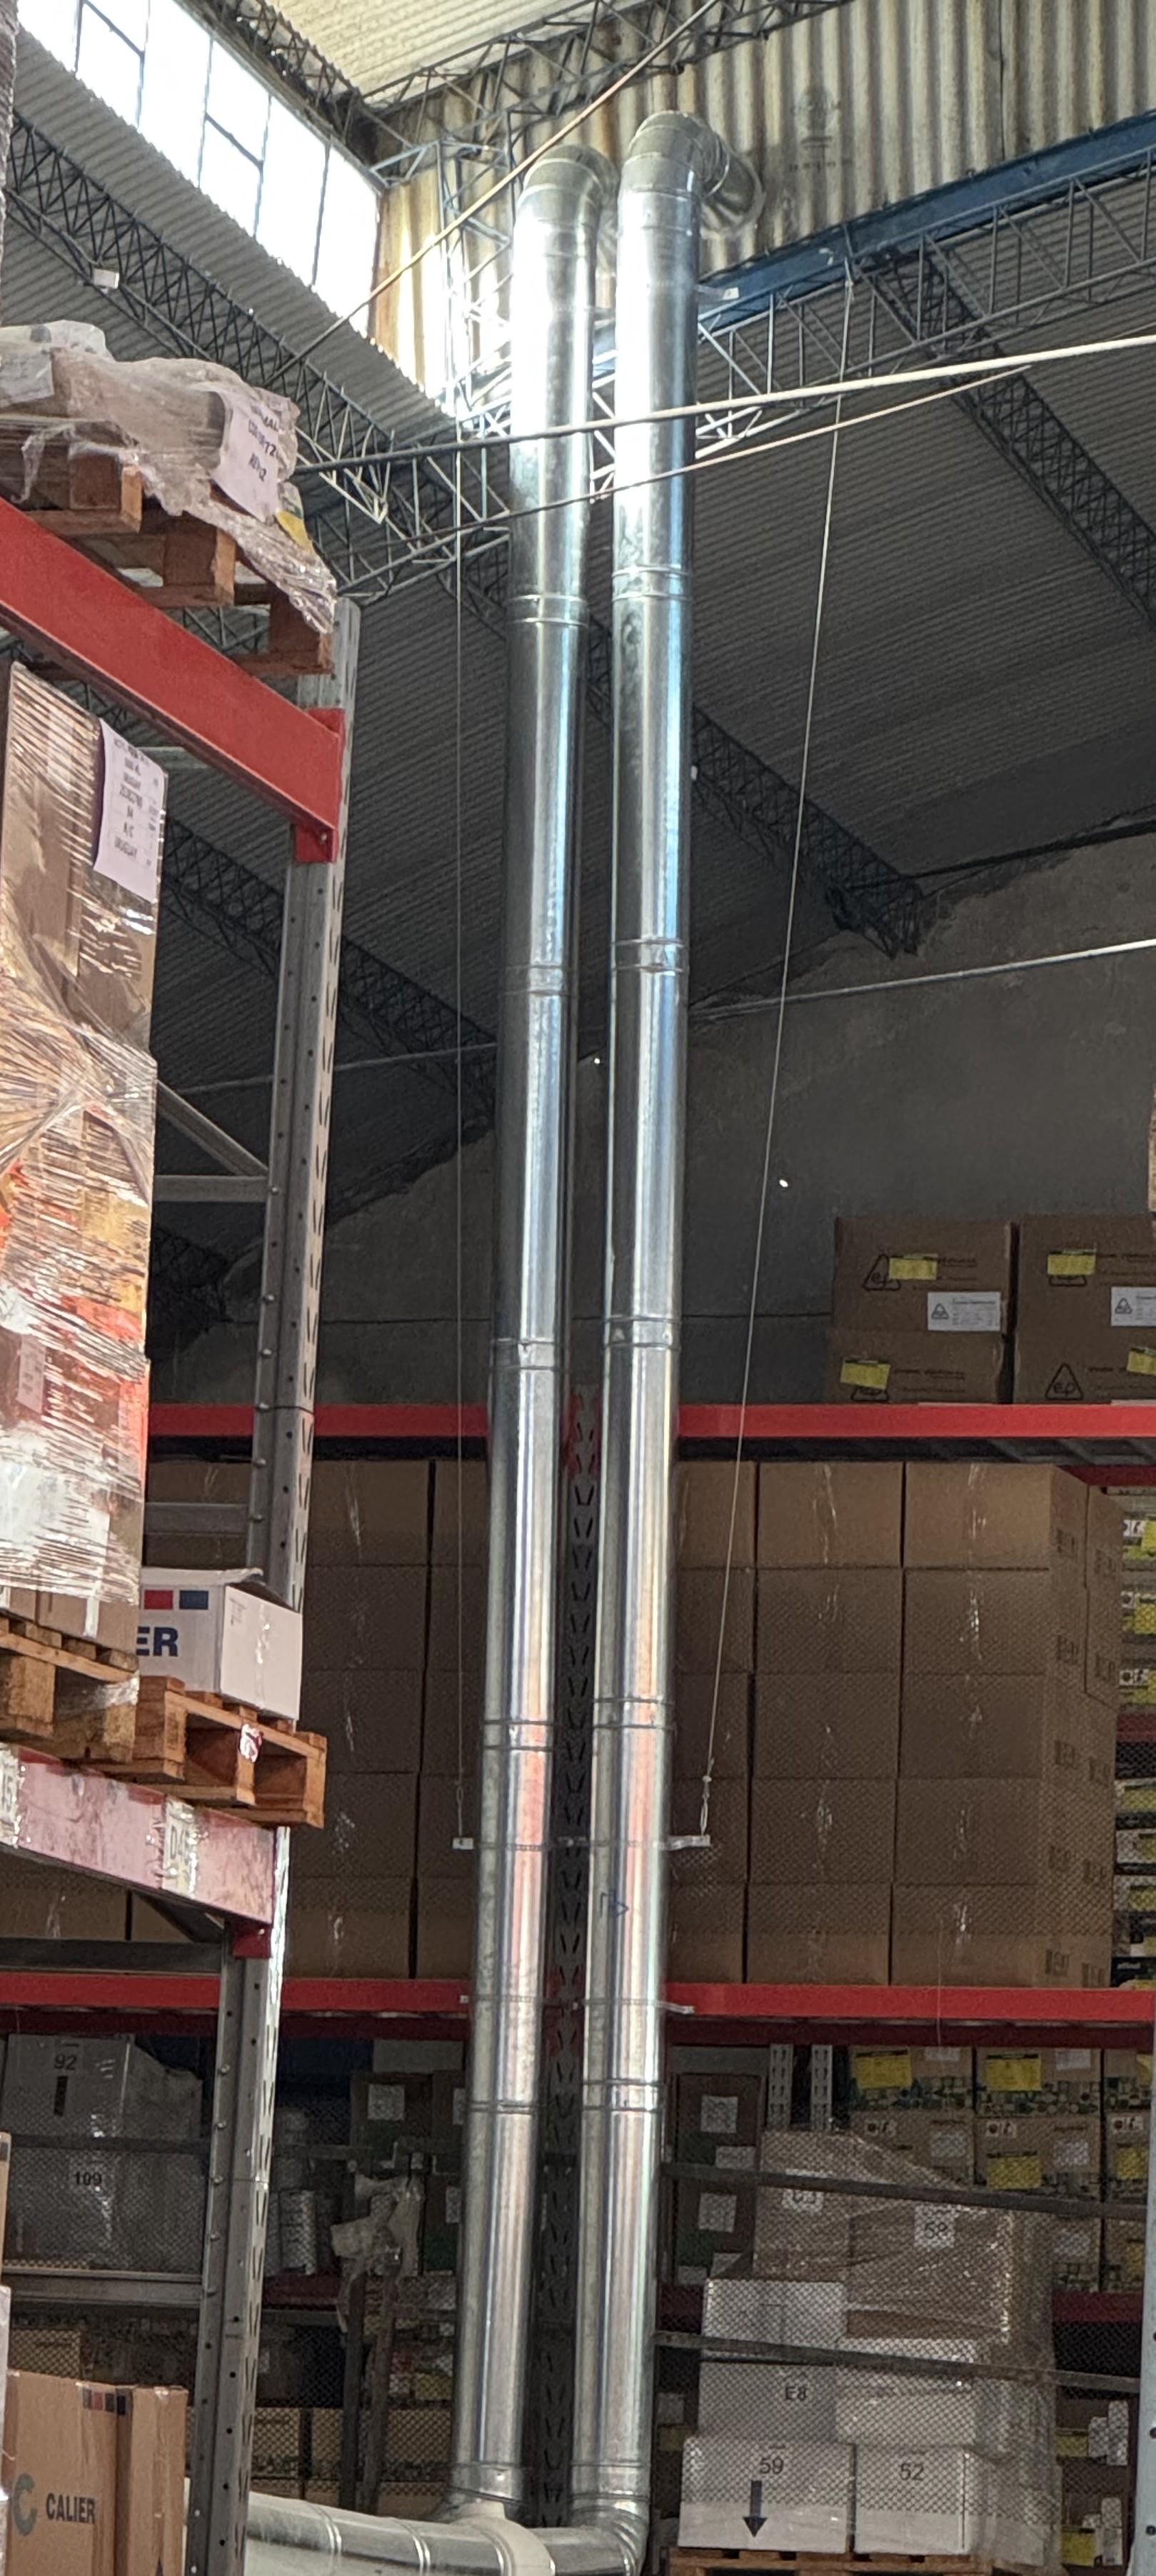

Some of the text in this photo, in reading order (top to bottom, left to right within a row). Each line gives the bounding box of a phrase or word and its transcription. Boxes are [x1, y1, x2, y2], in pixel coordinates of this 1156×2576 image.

[54, 2053, 77, 2071] 92
[75, 2171, 103, 2186] 109
[785, 2386, 807, 2401] E8
[759, 2456, 784, 2475] 59
[900, 2463, 925, 2480] 52
[46, 2492, 96, 2525] CALIER
